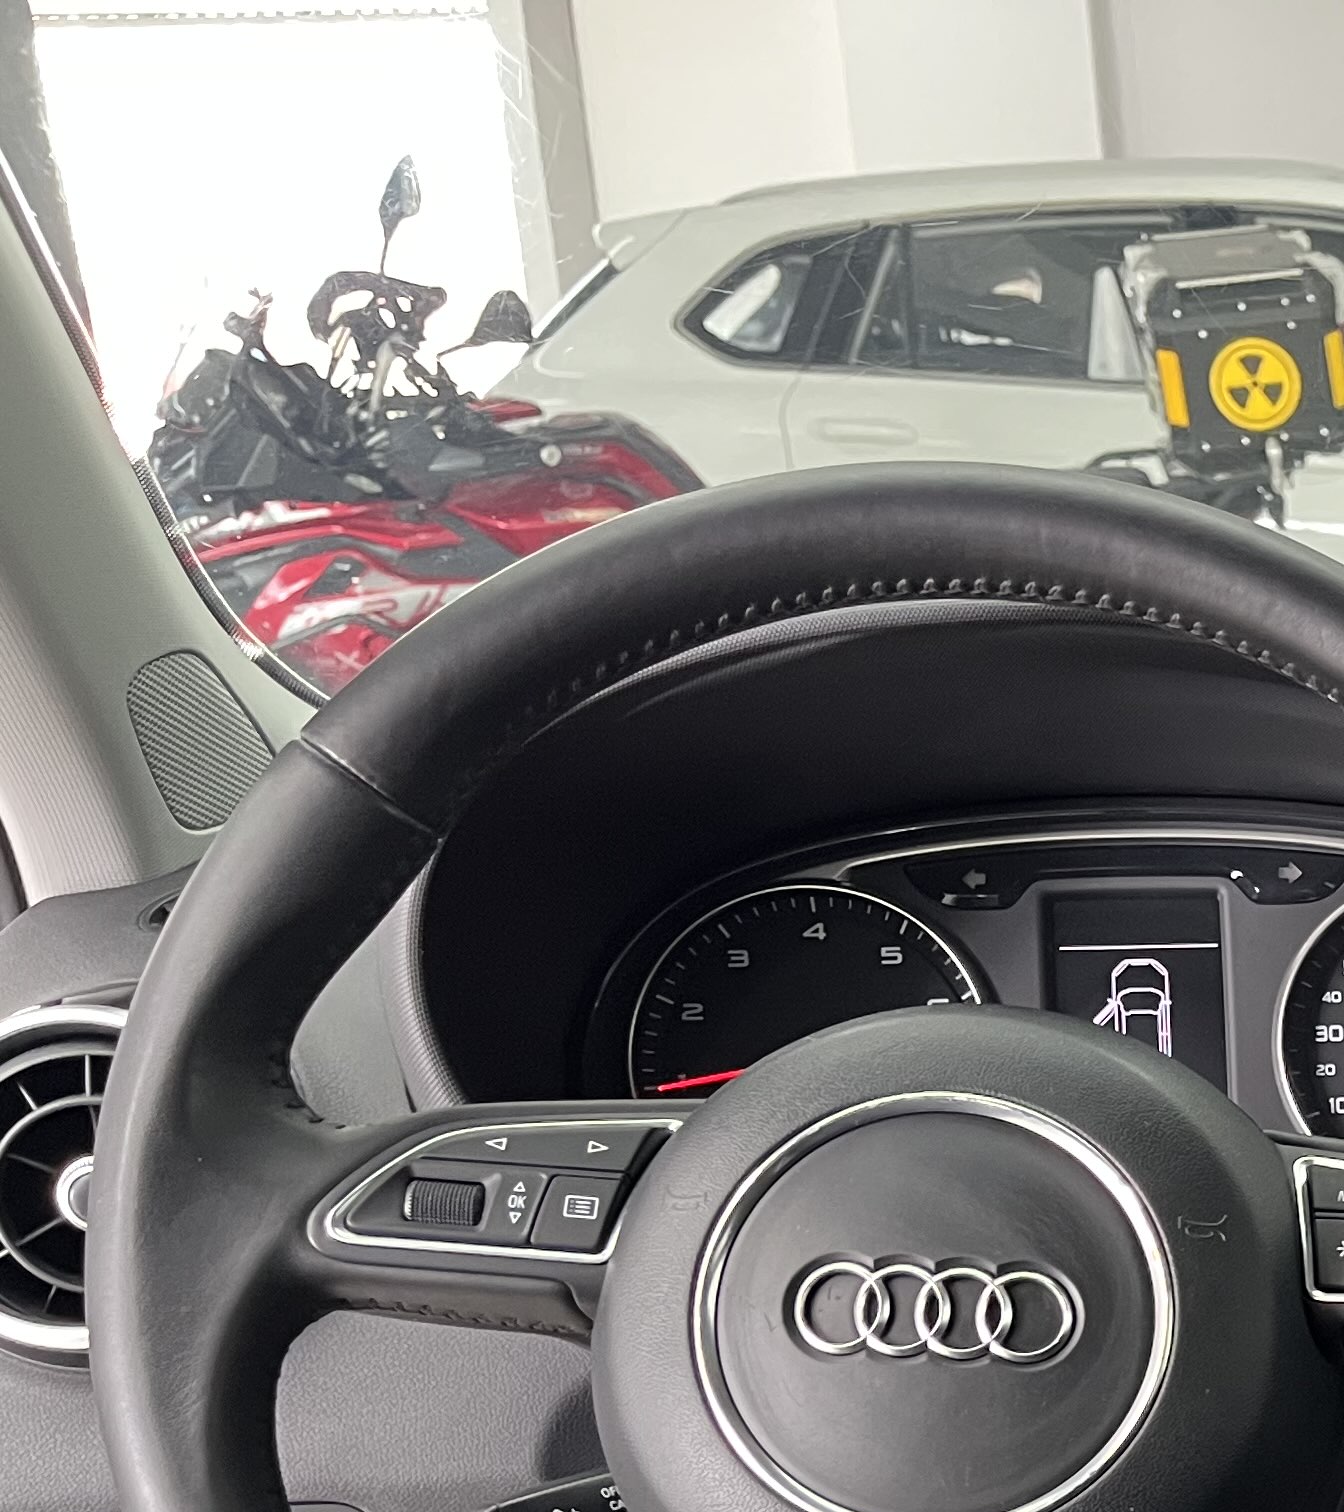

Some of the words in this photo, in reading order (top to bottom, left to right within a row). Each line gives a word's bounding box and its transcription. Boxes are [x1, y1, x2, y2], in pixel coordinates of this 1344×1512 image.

[802, 922, 827, 940] 4
[727, 949, 750, 968] 3
[880, 946, 903, 965] 5
[1321, 990, 1343, 1004] 40
[681, 1002, 705, 1021] 2
[1315, 1024, 1344, 1043] 30
[1315, 1063, 1336, 1077] 20
[507, 1194, 527, 1209] OK
